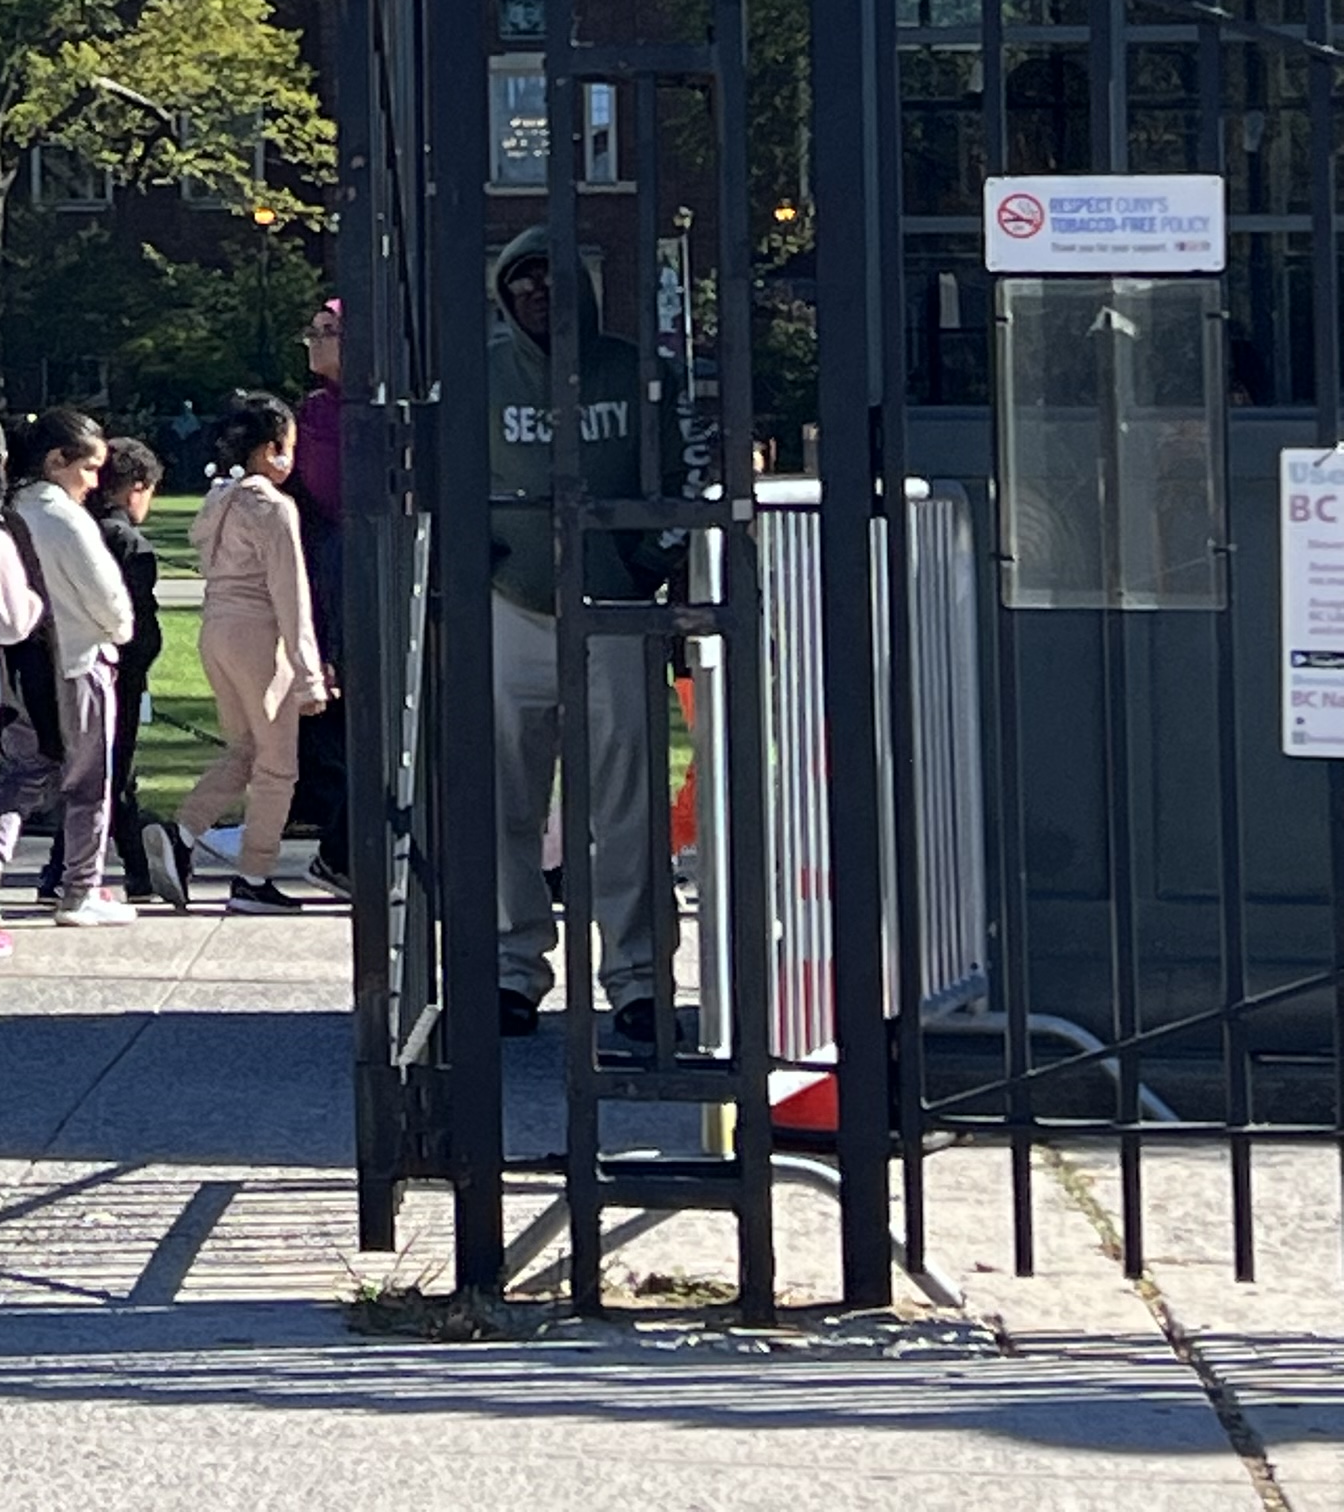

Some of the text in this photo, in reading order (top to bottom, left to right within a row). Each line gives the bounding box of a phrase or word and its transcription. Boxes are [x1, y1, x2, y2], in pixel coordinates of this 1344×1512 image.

[1049, 197, 1169, 213] RESPECT CUNY'S
[1050, 216, 1210, 232] TOBACCO-FREE POLICY
[1289, 494, 1338, 523] BC
[1292, 691, 1319, 708] BC
